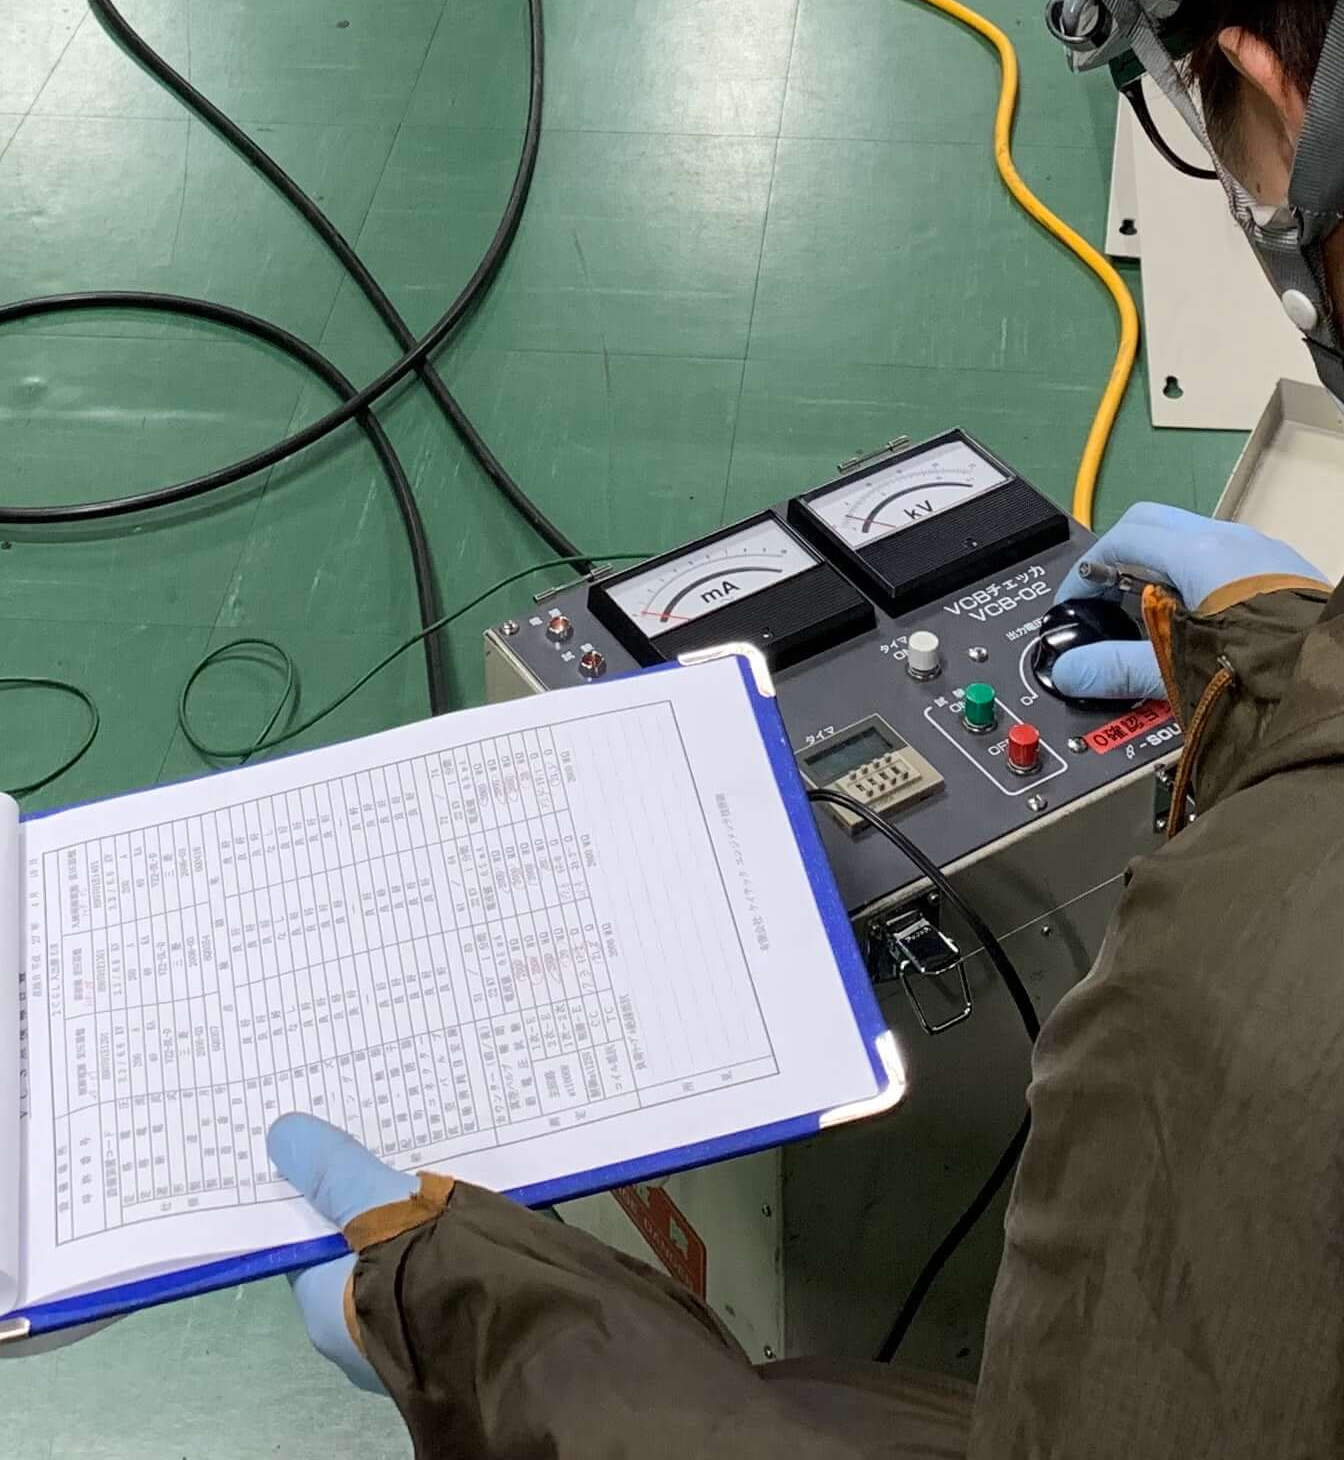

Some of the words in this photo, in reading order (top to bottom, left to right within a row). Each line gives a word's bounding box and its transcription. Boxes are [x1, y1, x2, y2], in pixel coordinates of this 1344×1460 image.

[903, 498, 934, 521] kV
[700, 579, 741, 604] mA
[943, 564, 1046, 617] VCBチェッカ
[967, 581, 1053, 623] VCB-02
[805, 725, 835, 746] タイマ
